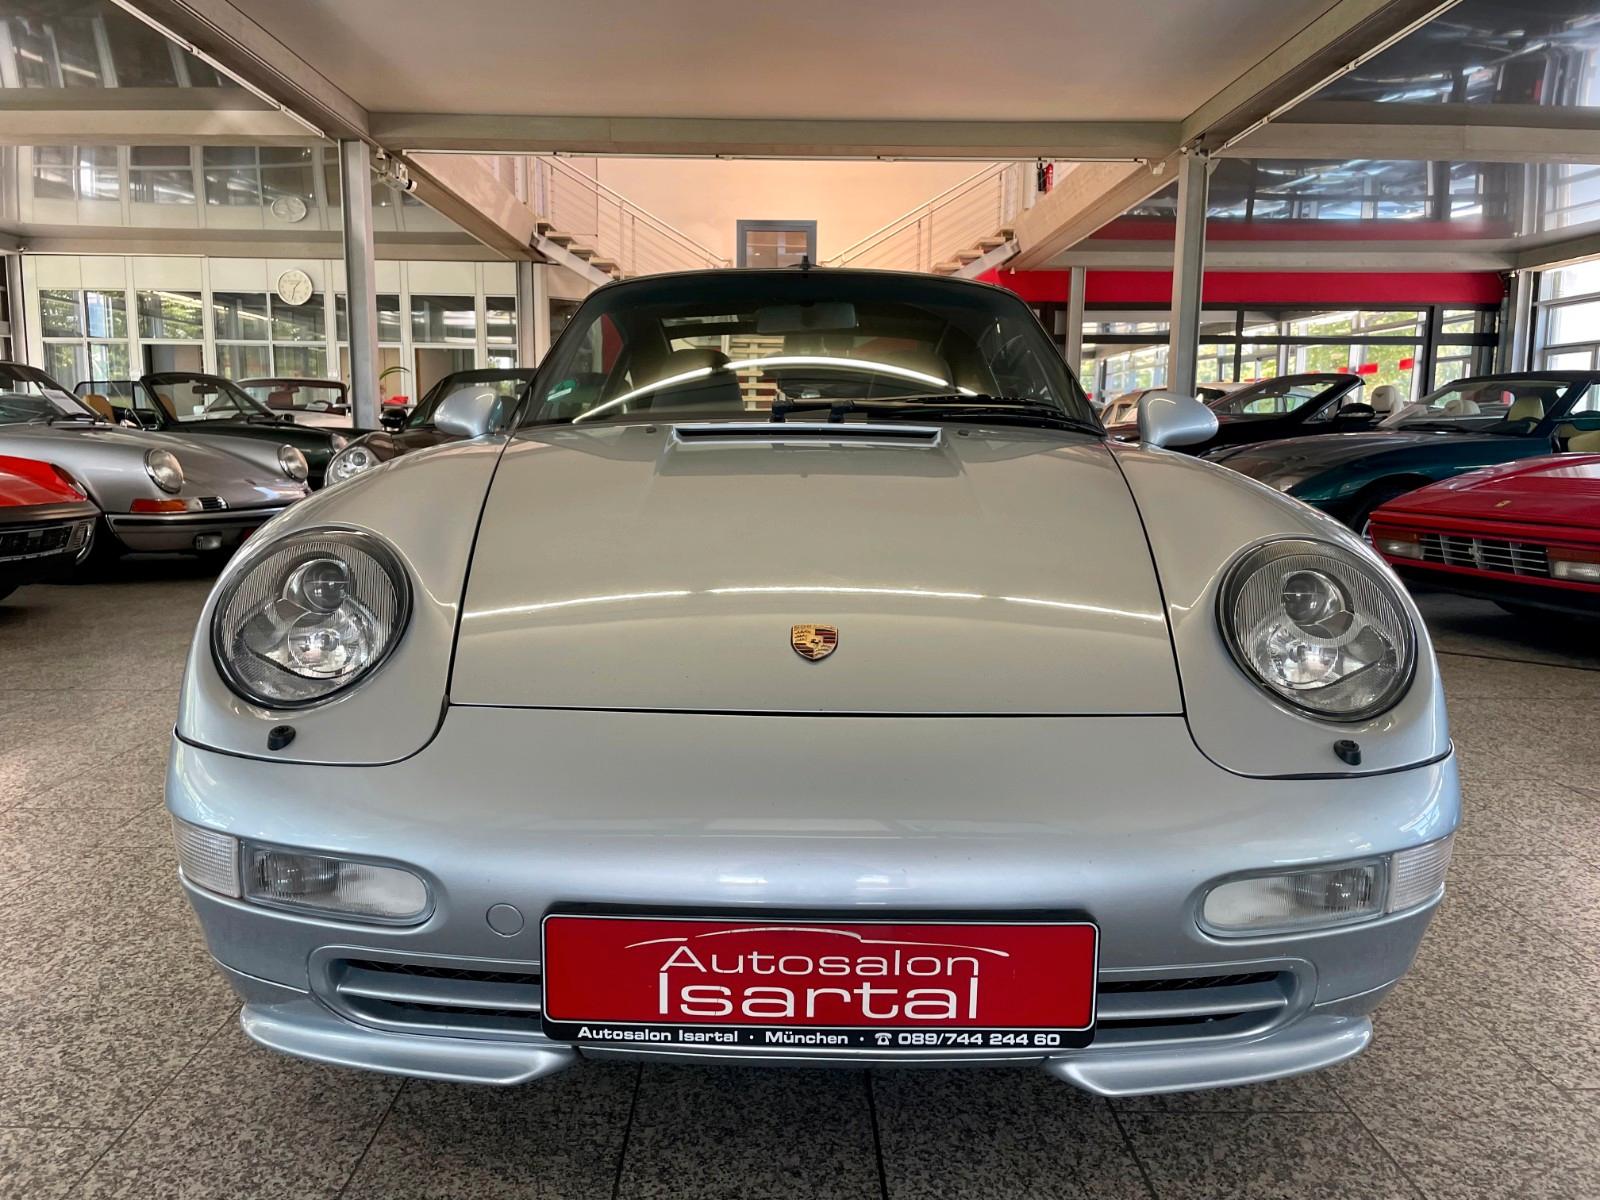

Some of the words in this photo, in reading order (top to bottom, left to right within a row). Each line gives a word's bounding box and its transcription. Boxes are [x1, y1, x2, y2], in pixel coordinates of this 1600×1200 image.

[659, 945, 979, 977] Autosalon
[659, 972, 979, 1019] Isartal
[577, 1026, 672, 1042] Autosalon
[678, 1029, 738, 1043] Isartal
[765, 1031, 849, 1045] München
[897, 1032, 984, 1046] 089/744
[989, 1033, 1029, 1046] 244
[1033, 1033, 1061, 1046] 60
